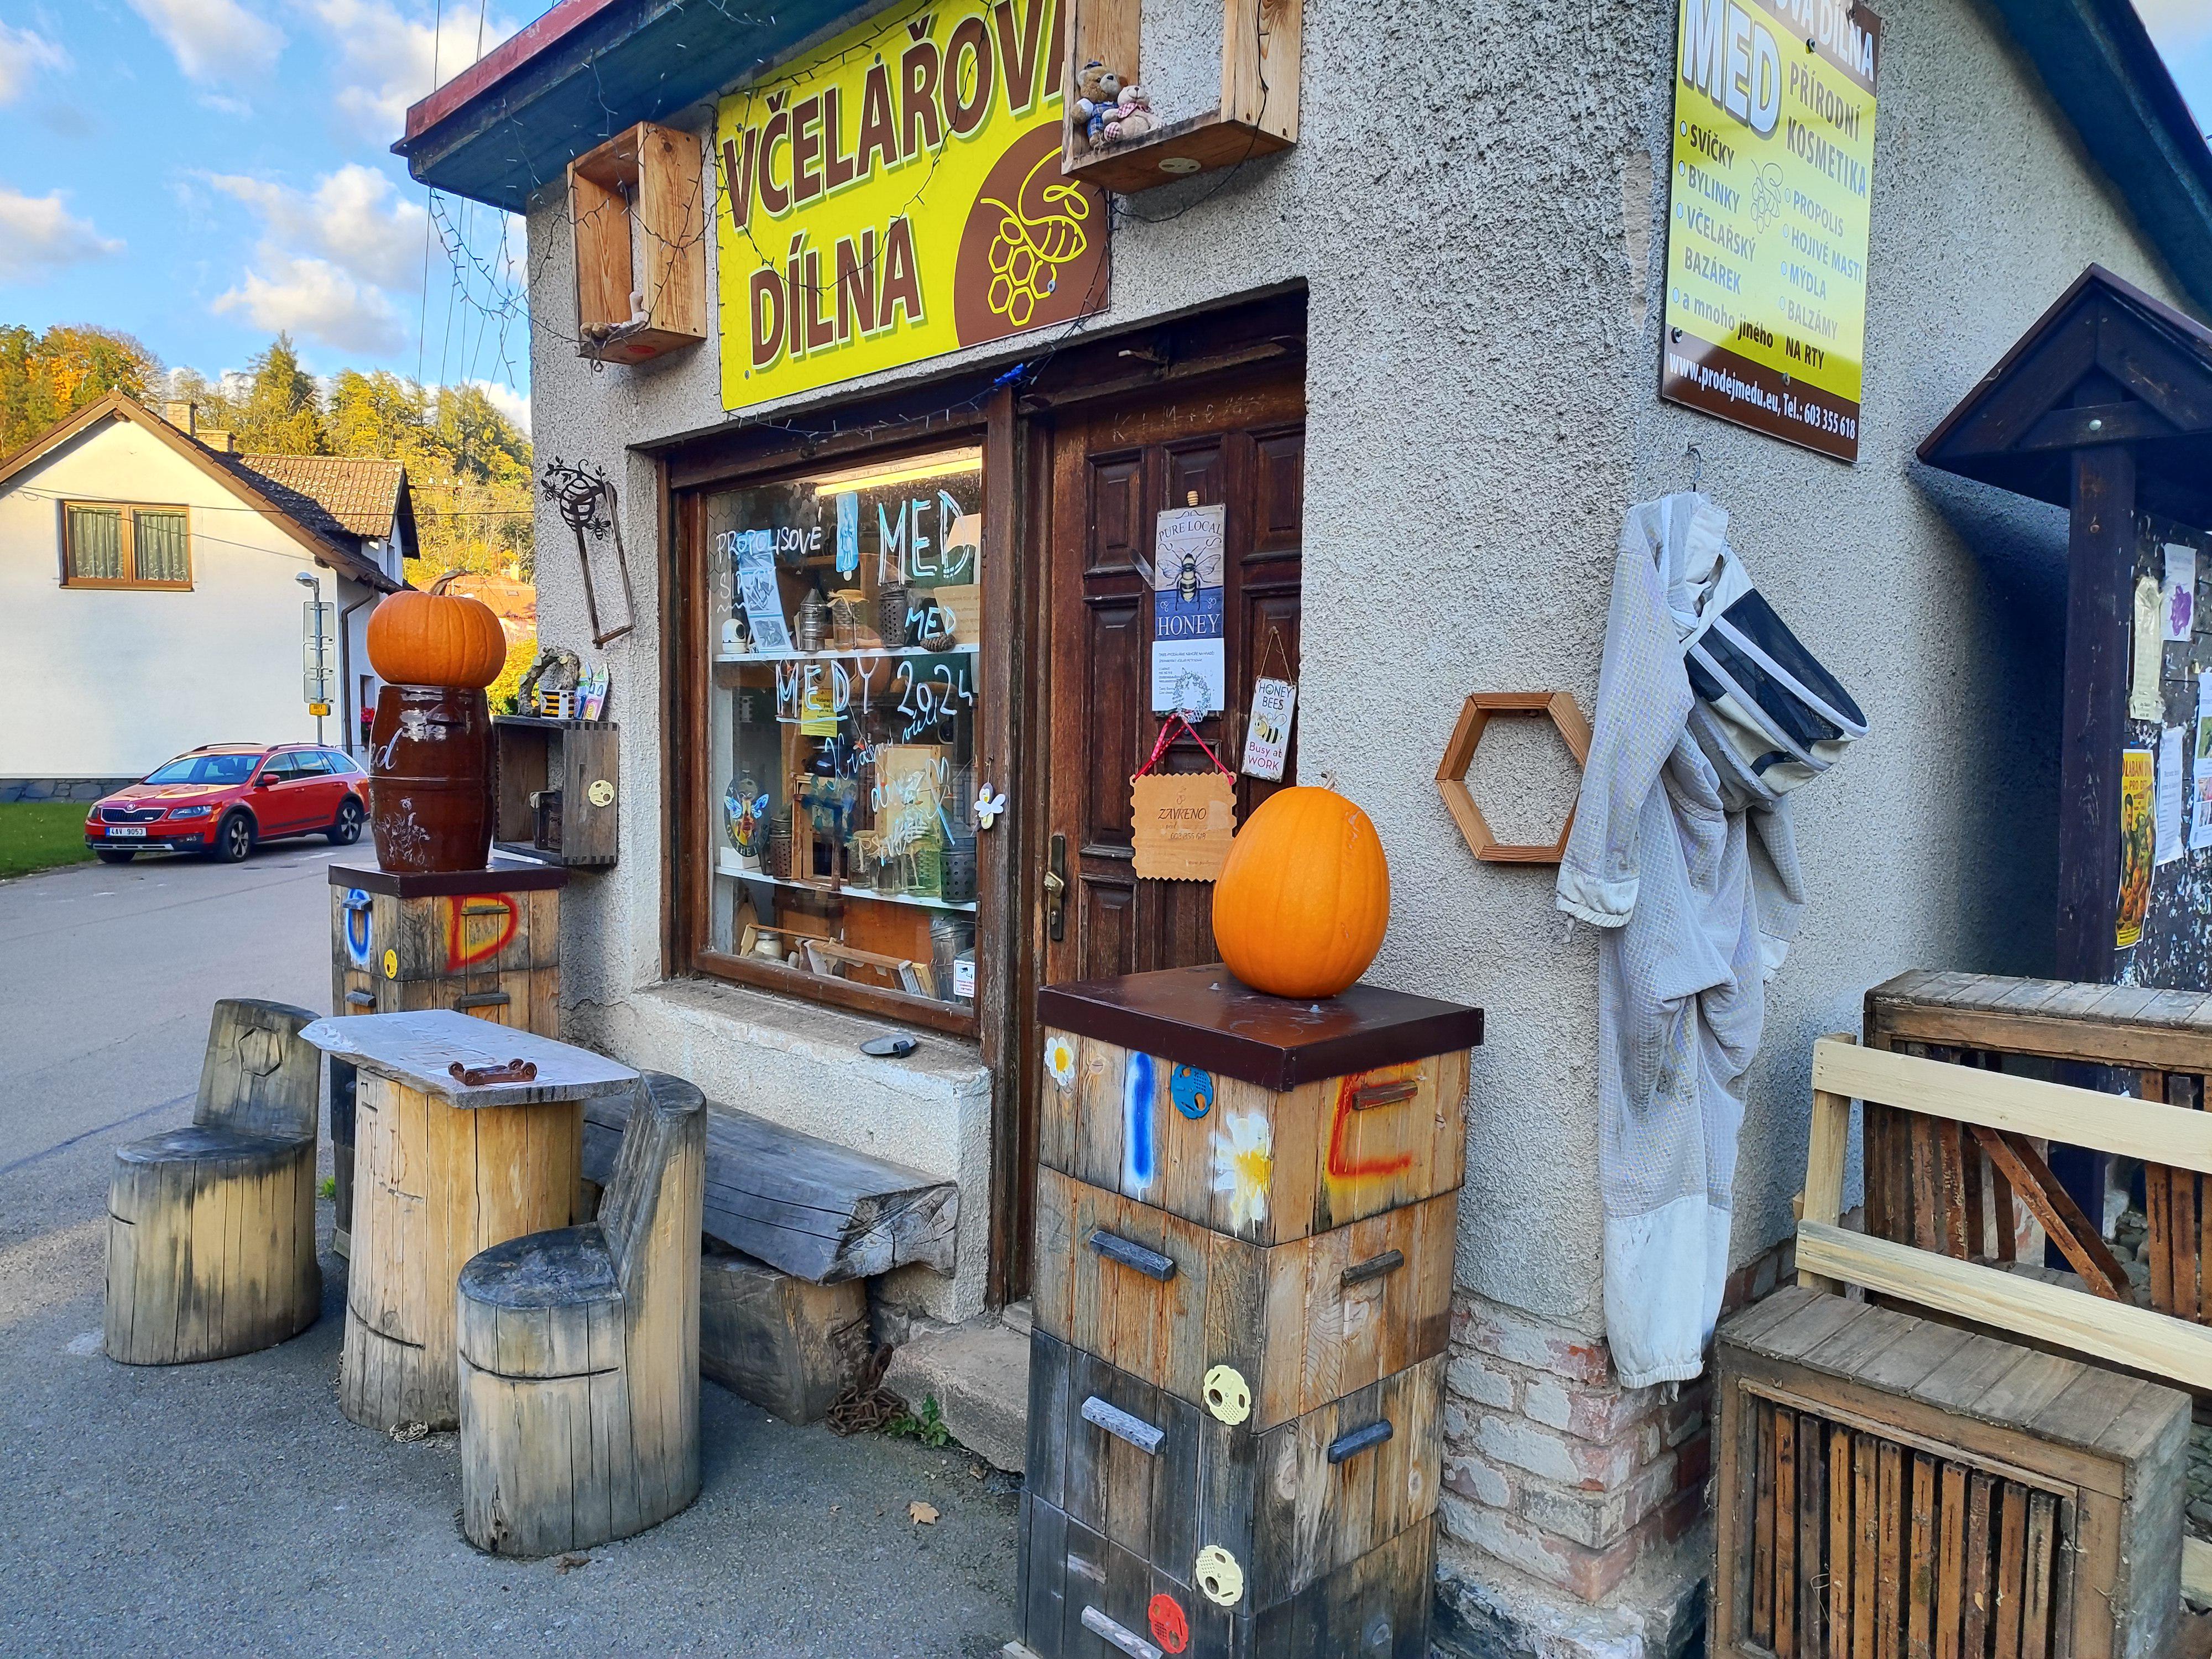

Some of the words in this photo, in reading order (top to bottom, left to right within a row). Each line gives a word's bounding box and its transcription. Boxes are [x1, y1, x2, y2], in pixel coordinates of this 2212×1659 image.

[1682, 0, 1781, 135] MED
[1790, 61, 1860, 142] PŘÍRODNÍ
[1690, 124, 1735, 170] SVÍČKY
[1787, 116, 1866, 199] KOSMETIKA
[1688, 164, 1740, 214] BYLINKY
[1687, 206, 1756, 262] VČELAŘSKÝ
[1793, 190, 1844, 238] PROPOLIS
[1684, 246, 1741, 295] BAZÁREK
[1792, 226, 1829, 265] HOJIVÉ
[1831, 251, 1862, 283] MASTI
[749, 213, 925, 371] DÍLNA
[1790, 262, 1827, 301] MÝDLA
[1682, 292, 1689, 311] a
[1694, 297, 1735, 331] mnoho
[1738, 313, 1773, 348] jiného
[1787, 299, 1839, 341] BALZÁMY
[1786, 336, 1801, 361] NA
[1804, 345, 1824, 371] RTY
[1669, 352, 1781, 418] www.prodejmedu.eu,
[1783, 393, 1803, 422] Tel.:
[1804, 403, 1820, 426] 603
[1823, 408, 1838, 434] 355
[1839, 414, 1855, 440] 618
[878, 490, 971, 587] MED
[1158, 523, 1185, 542] PURE
[1187, 520, 1222, 535] LOCAL
[905, 606, 956, 644] MED
[1157, 613, 1221, 637] HONEY
[776, 654, 879, 718] MEDY
[897, 660, 973, 716] 2024
[1259, 682, 1292, 698] HONEY
[1262, 696, 1284, 710] BEES
[370, 727, 403, 770] ed
[1248, 755, 1279, 771] WORK
[1249, 741, 1270, 758] Busy
[1272, 749, 1282, 758] at
[736, 841, 752, 856] THE
